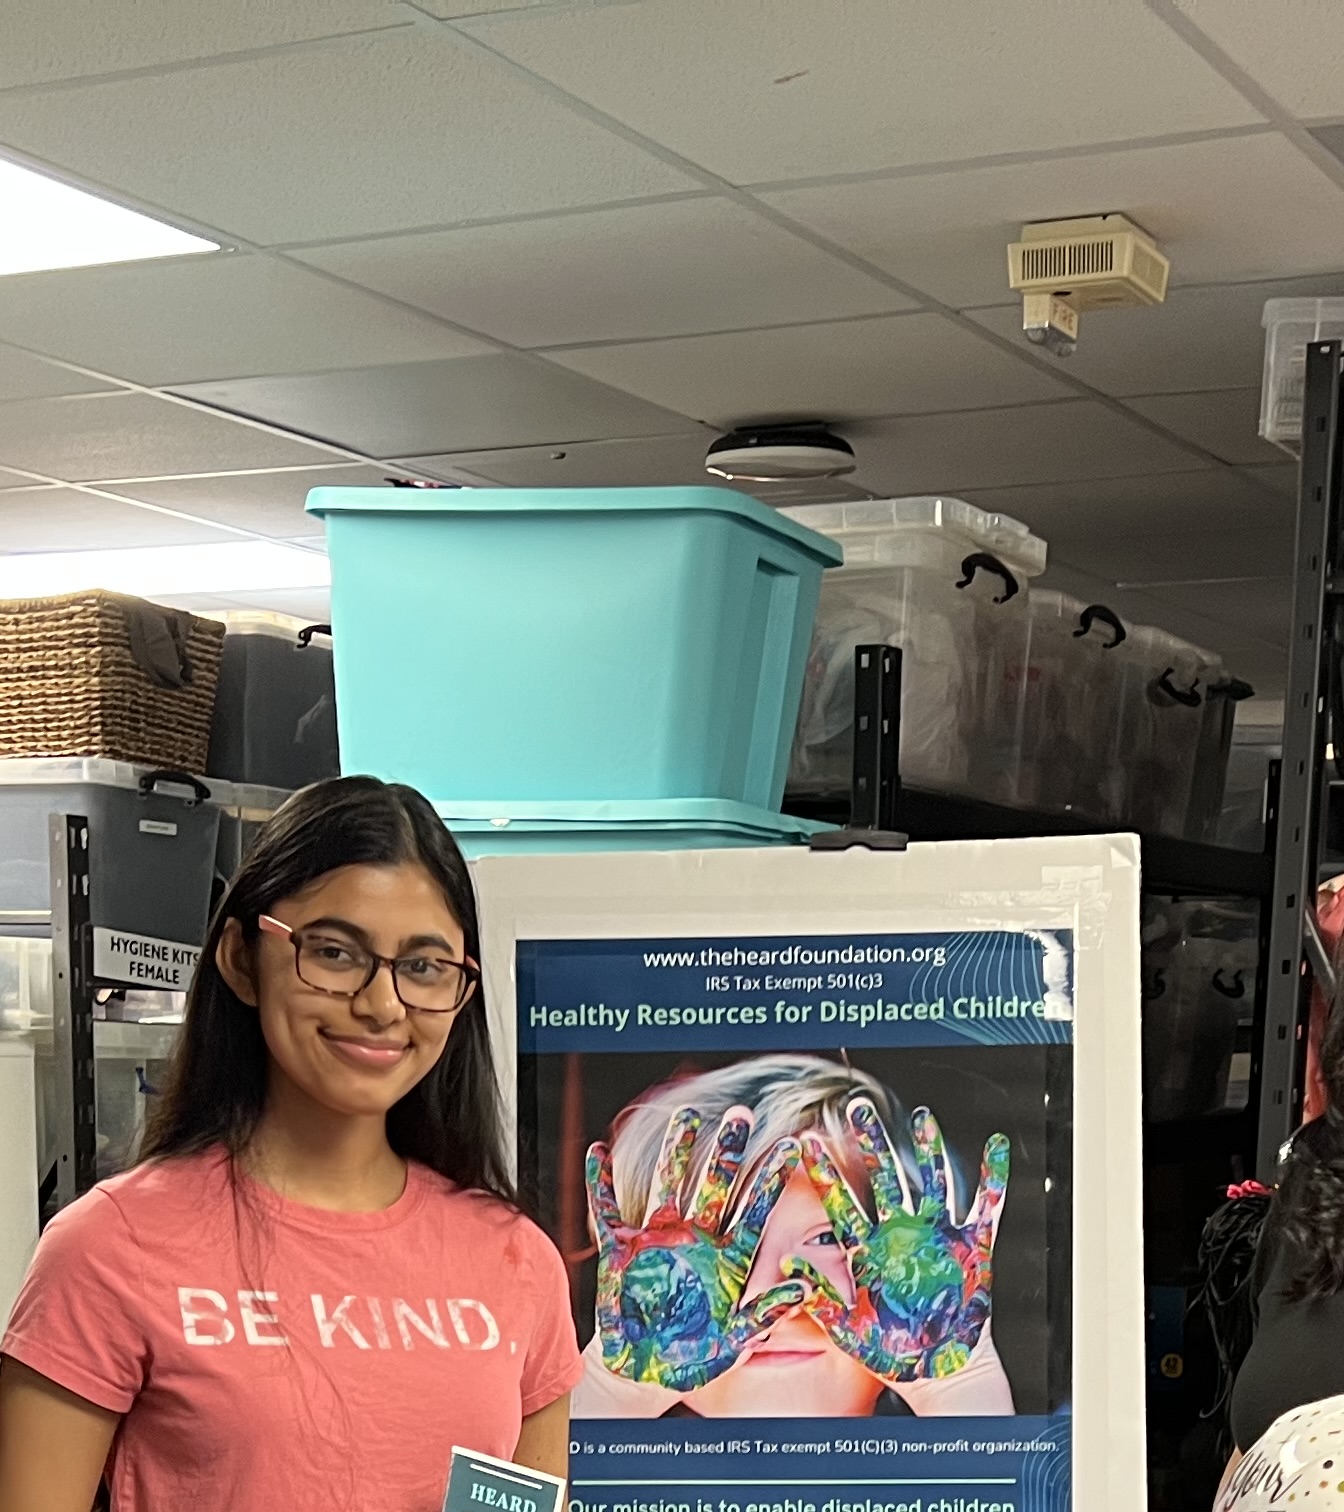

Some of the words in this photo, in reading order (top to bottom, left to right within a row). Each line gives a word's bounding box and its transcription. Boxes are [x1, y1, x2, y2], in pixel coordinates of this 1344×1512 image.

[110, 936, 169, 962] HYGIENE
[172, 947, 201, 967] KITS
[642, 944, 947, 969] www.theheardfoundation.org
[129, 961, 179, 984] FEMALE
[705, 976, 731, 992] IRS
[734, 976, 761, 991] Tax
[765, 974, 824, 993] Exempt
[827, 972, 884, 991] 501(c)3
[529, 1004, 630, 1031] Healthy
[636, 1001, 767, 1026] Resources
[774, 1001, 811, 1023] for
[820, 998, 946, 1028] Displaced
[952, 996, 1060, 1020] Childre
[177, 1286, 291, 1347] BE
[583, 1440, 595, 1454] is
[598, 1444, 607, 1454] a
[609, 1441, 681, 1457] community
[684, 1440, 725, 1455] based
[727, 1440, 751, 1455] IRS
[754, 1440, 779, 1455] Tax
[781, 1441, 831, 1457] exempt
[834, 1439, 899, 1456] 501(C)(3)
[901, 1438, 970, 1457] non-profit
[972, 1438, 1060, 1456] organization.
